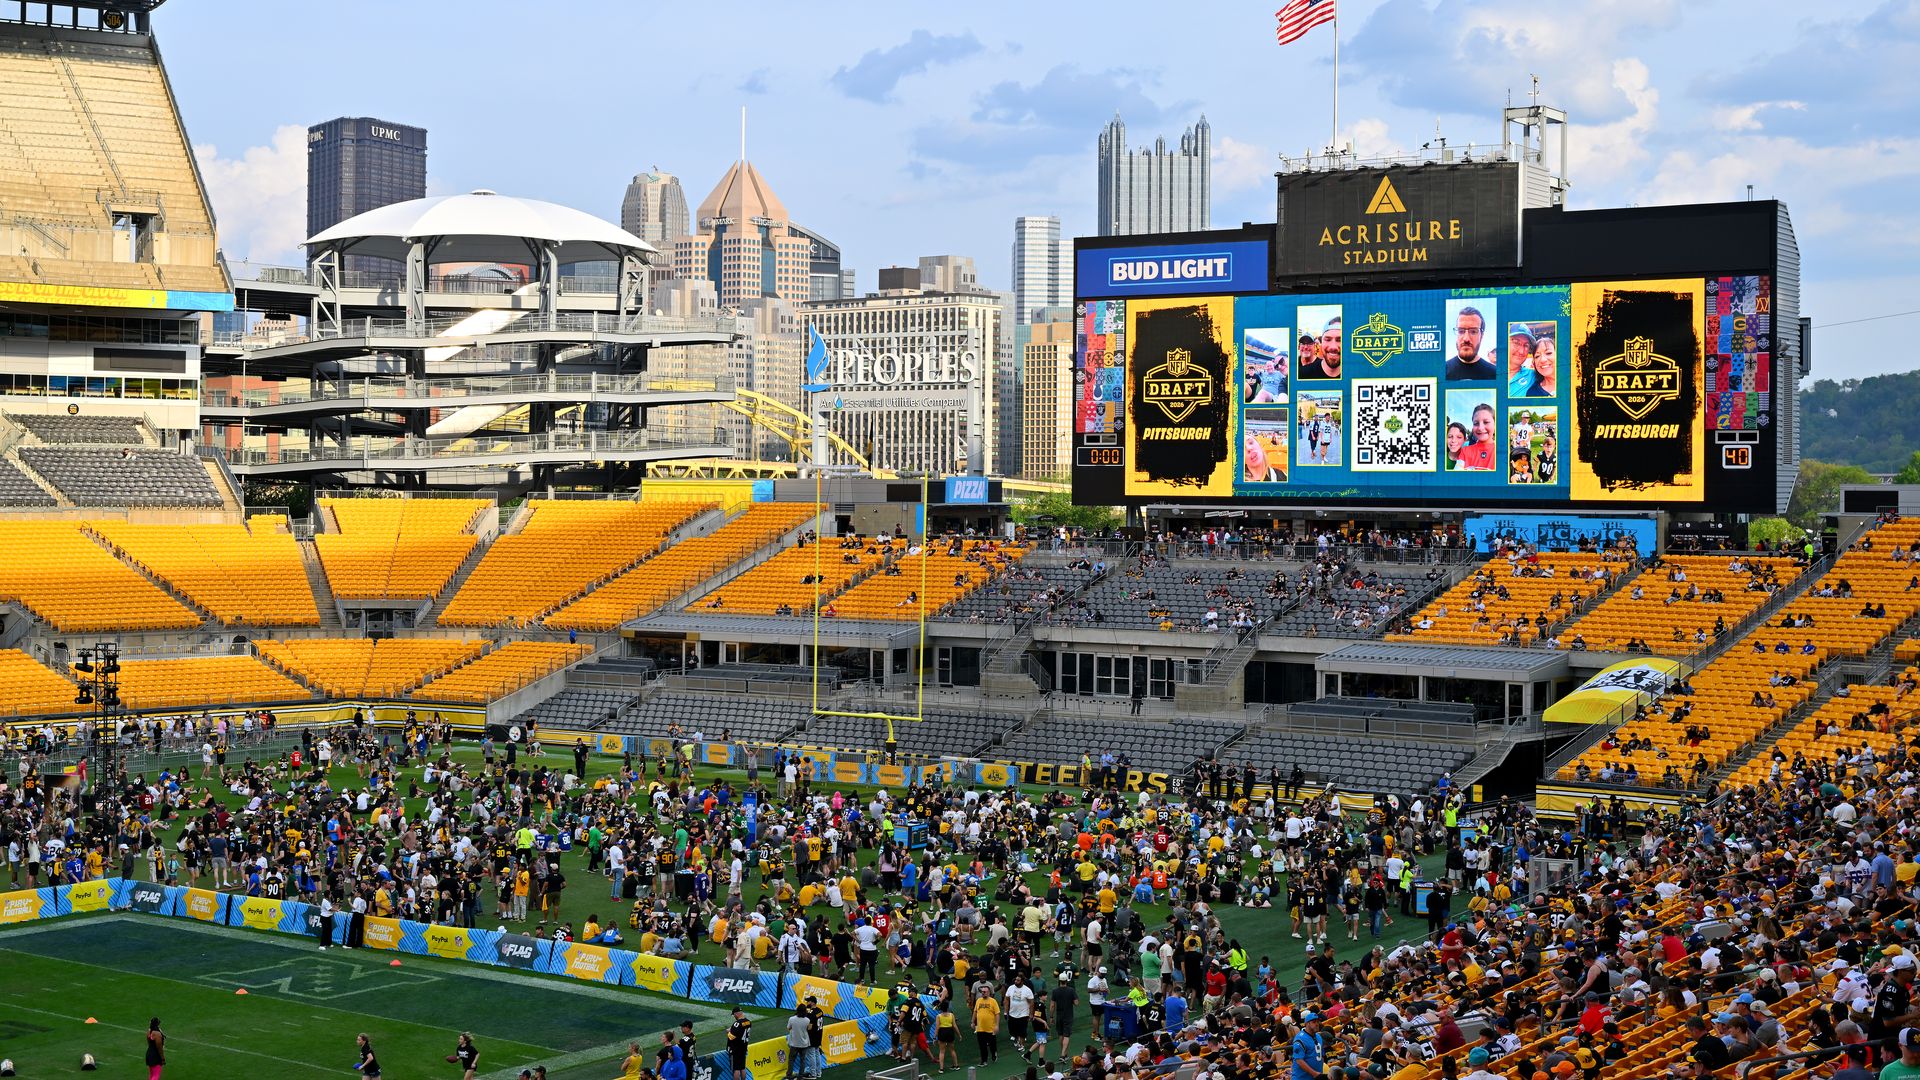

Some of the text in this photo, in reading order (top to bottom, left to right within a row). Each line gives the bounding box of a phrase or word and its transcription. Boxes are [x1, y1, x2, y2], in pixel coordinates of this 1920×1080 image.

[106, 15, 121, 26] 504
[371, 126, 410, 141] UPMC
[1319, 219, 1461, 246] ACRISURE
[1344, 248, 1428, 265] STADIUM
[1113, 258, 1228, 281] BUD LIGHT
[1356, 337, 1399, 347] DRAFT
[1414, 333, 1435, 341] BUD
[1410, 341, 1439, 349] LIGHT
[1628, 351, 1646, 362] NFL
[835, 349, 976, 385] PEOPLES
[1170, 361, 1184, 373] NFL
[1602, 374, 1672, 389] DRAFT
[1149, 382, 1205, 395] DRAFT
[820, 396, 966, 410] An Essential Utilities Company
[1143, 427, 1211, 440] PITTSBURGH
[1519, 429, 1527, 439] 43
[1595, 424, 1679, 439] PITTSBURGH
[1090, 449, 1119, 464] 0:00
[1726, 448, 1748, 465] 40
[1542, 463, 1553, 474] 90
[953, 480, 985, 499] PIZZA
[1480, 527, 1529, 541] PICK
[1158, 812, 1168, 820] 58
[1306, 820, 1315, 828] 12
[1158, 836, 1167, 845] 53
[496, 849, 505, 857] 90
[811, 843, 820, 852] 90
[1554, 843, 1560, 852] 7
[1574, 843, 1579, 852] 7
[662, 854, 672, 863] 90
[1226, 854, 1235, 863] 88
[75, 863, 81, 872] 17
[268, 884, 278, 895] 90
[75, 892, 91, 900] PayPal
[138, 890, 161, 903] FLAG
[1307, 896, 1315, 906] 14
[977, 901, 987, 909] 33
[248, 907, 264, 915] PayPal
[876, 918, 886, 928] 88
[1550, 914, 1564, 926] 36
[431, 935, 448, 943] PayPal
[554, 930, 565, 940] 36
[506, 943, 533, 958] FLAG
[640, 965, 655, 974] PayPal
[1009, 958, 1016, 970] 5
[719, 978, 754, 994] FLAG
[1886, 984, 1896, 993] 20
[911, 1007, 922, 1021] 90
[1149, 1010, 1159, 1021] 22
[829, 1042, 857, 1057] FOOTBALL
[1315, 1044, 1322, 1061] 9
[754, 1056, 771, 1067] PayPal
